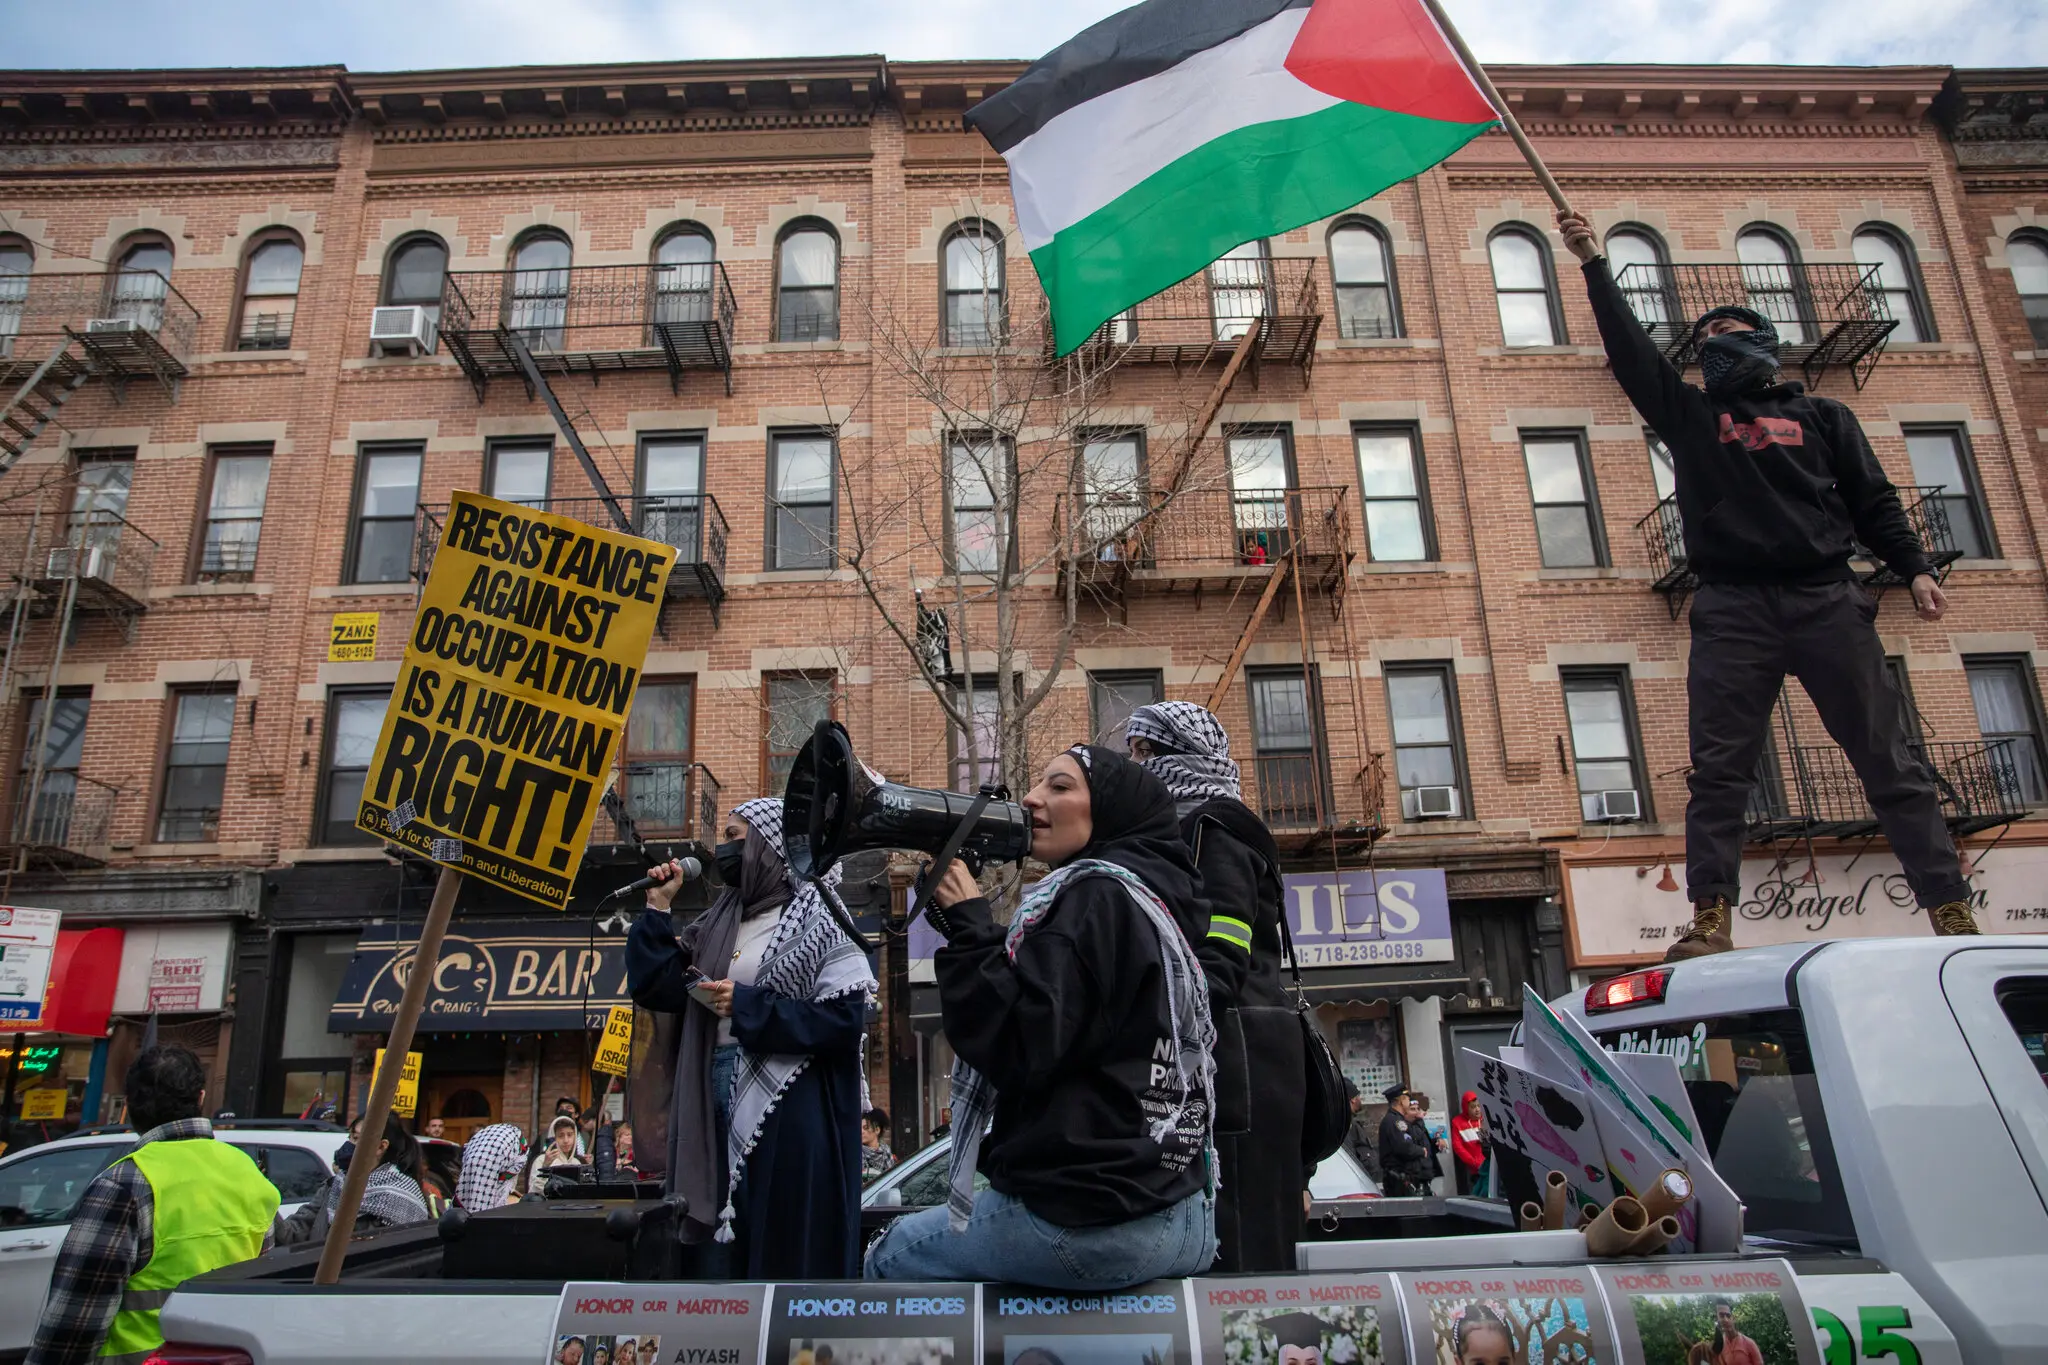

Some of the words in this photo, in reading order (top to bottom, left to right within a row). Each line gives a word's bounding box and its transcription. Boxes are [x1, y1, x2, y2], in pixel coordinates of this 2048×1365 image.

[446, 501, 668, 604] RESISTANCE
[459, 564, 621, 650] AGAINST
[332, 623, 377, 645] ZANIS
[415, 606, 637, 715] OCCUPATION
[400, 666, 441, 718] IS
[436, 680, 465, 730] A
[466, 687, 613, 776] HUMAN
[374, 717, 593, 872] RIGHT!
[380, 818, 406, 840] Paty
[406, 827, 422, 845] for
[476, 857, 499, 877] and
[500, 866, 564, 900] Liberation
[1291, 881, 1420, 936] ILS
[1739, 874, 1884, 932] Bagel
[2006, 908, 2048, 921] 718-74
[1640, 926, 1667, 939] 7221
[1314, 942, 1424, 964] 718-238-0838
[163, 964, 205, 976] RENT
[507, 949, 603, 996] BAR
[586, 1014, 607, 1028] 721
[608, 1022, 628, 1039] U.S.
[601, 1049, 629, 1066] ISRA
[400, 1068, 416, 1081] AID
[391, 1094, 414, 1108] AEL!
[1178, 1164, 1187, 1173] IT
[1414, 1280, 1475, 1296] HONOR
[1481, 1281, 1506, 1293] OUR
[1513, 1279, 1584, 1295] MARTYRS
[1613, 1274, 1674, 1290] HONOR
[1678, 1275, 1704, 1287] OUR
[1711, 1272, 1782, 1288] MARTYRS
[1208, 1288, 1268, 1305] HONOR
[1276, 1289, 1300, 1301] OUR
[1309, 1285, 1382, 1302] MARTYRS
[574, 1298, 634, 1314] HONOR
[642, 1300, 668, 1312] OUR
[676, 1298, 750, 1315] MARTYRS
[787, 1298, 856, 1316] HONOR
[860, 1301, 888, 1315] OUR
[895, 1297, 966, 1316] HEROES
[999, 1296, 1070, 1316] HONOR
[1071, 1298, 1102, 1312] OUR
[1102, 1295, 1177, 1315] HEROES
[674, 1348, 740, 1365] AYYASH
